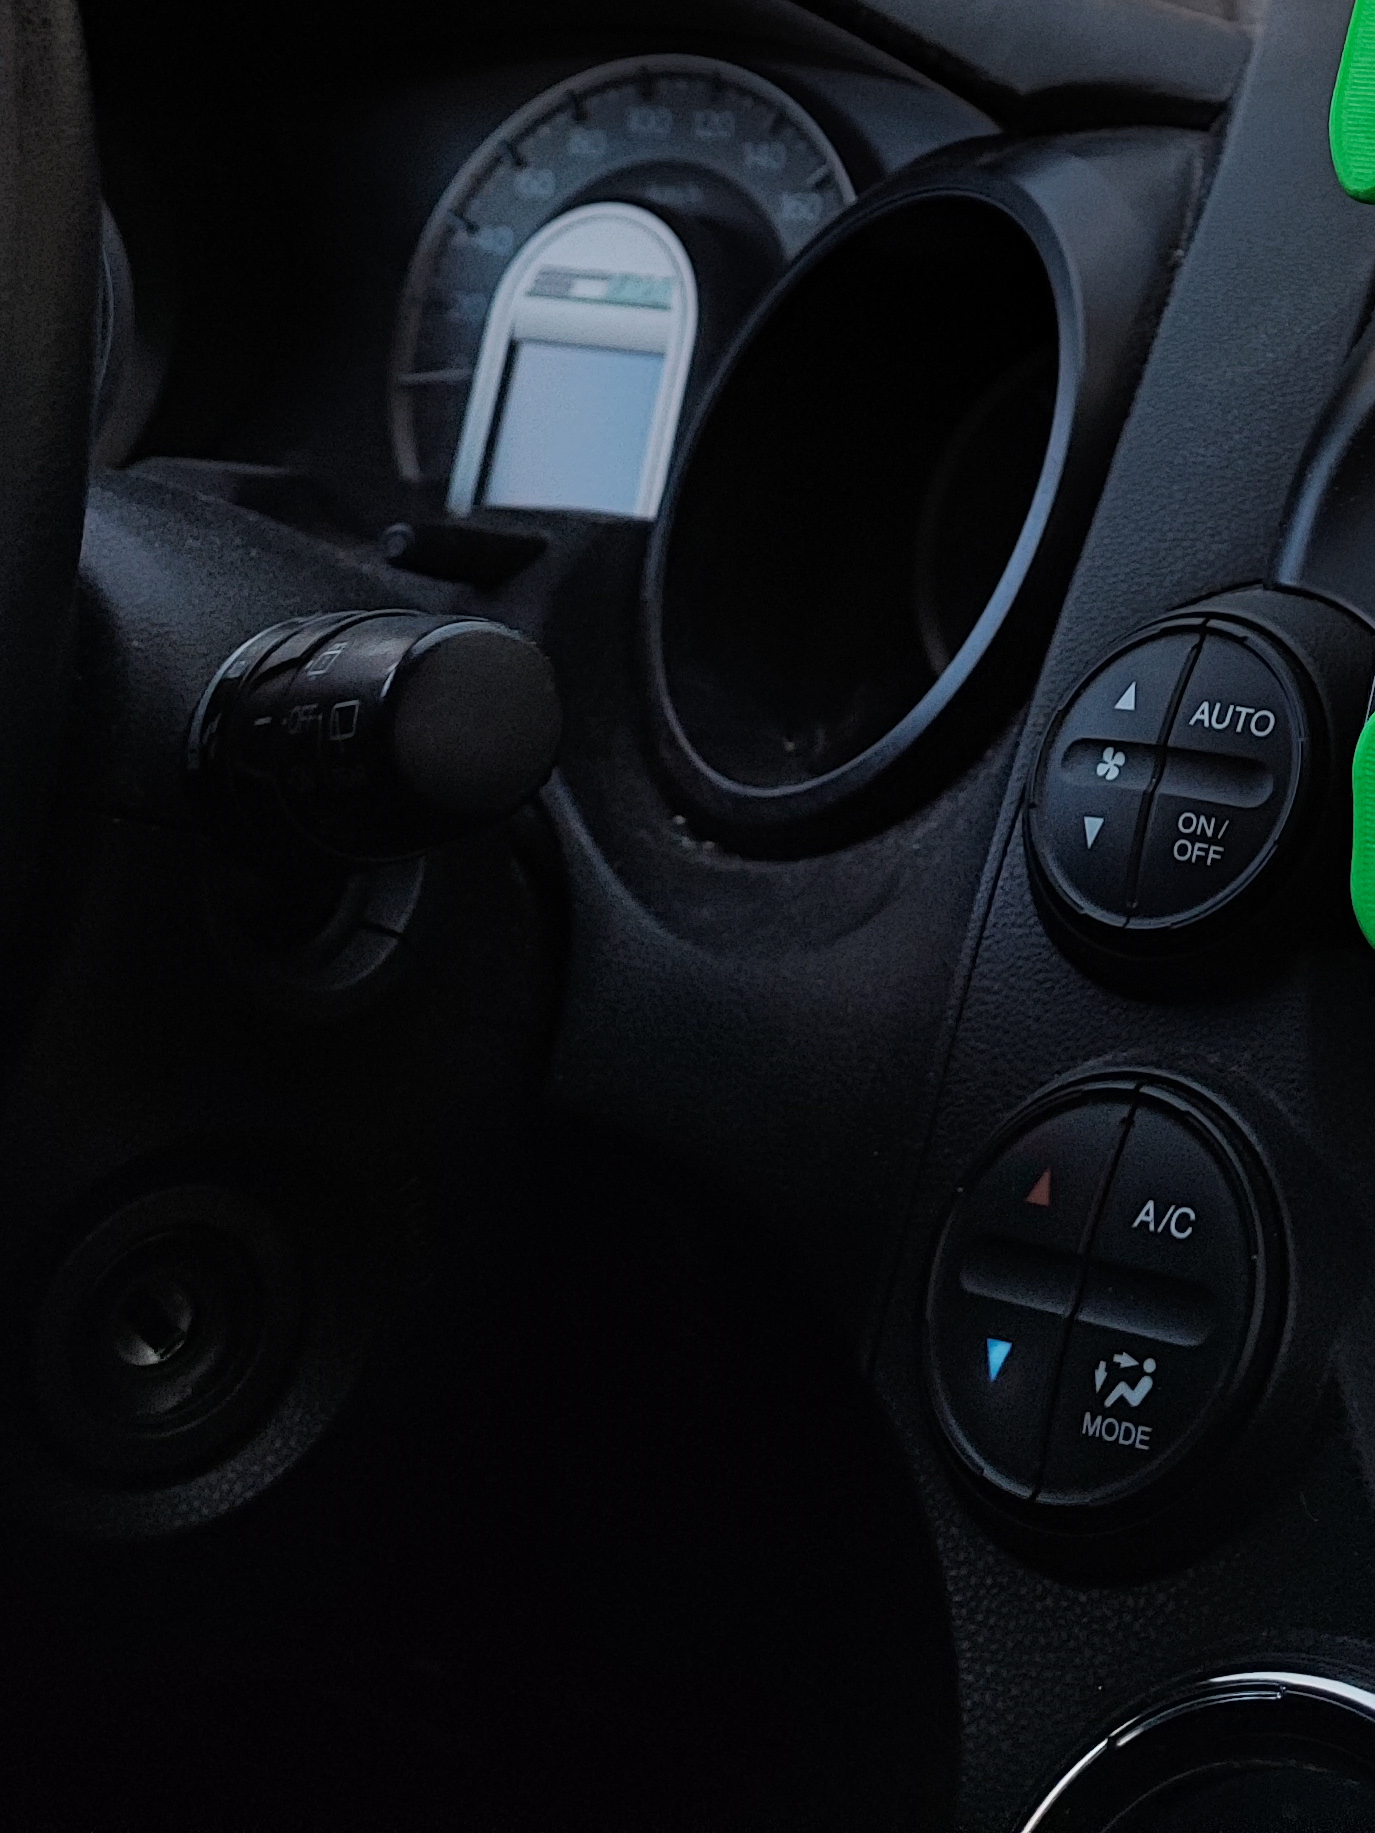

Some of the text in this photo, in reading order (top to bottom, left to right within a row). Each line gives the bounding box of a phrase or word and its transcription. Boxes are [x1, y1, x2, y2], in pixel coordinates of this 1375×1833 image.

[1189, 701, 1276, 737] AUTO
[1173, 839, 1225, 867] OFF
[1132, 1199, 1196, 1240] A/C
[1081, 1411, 1153, 1451] MODE
